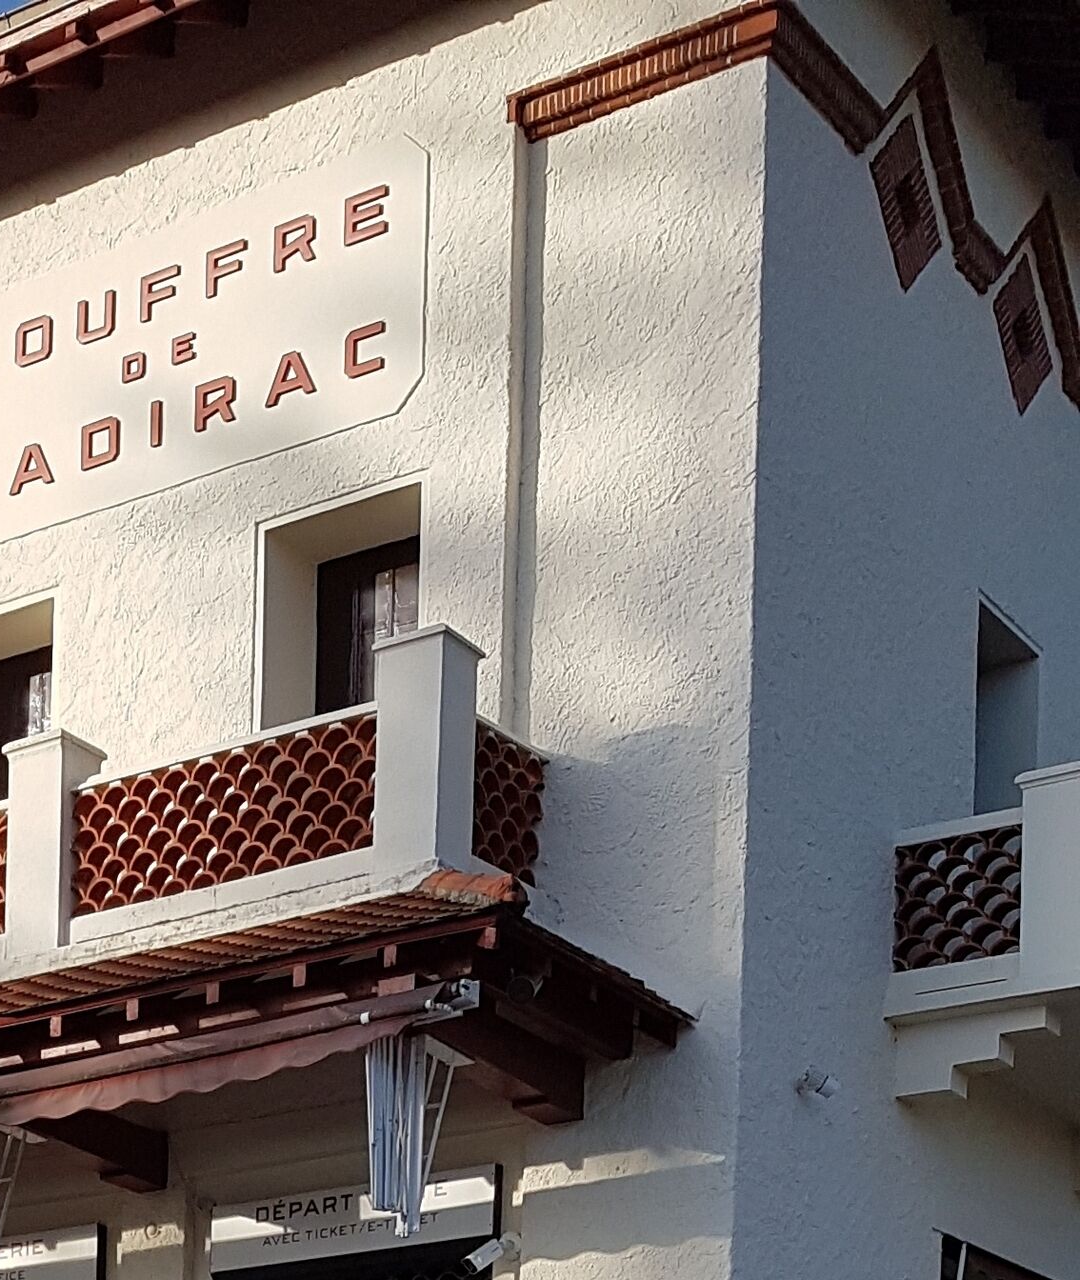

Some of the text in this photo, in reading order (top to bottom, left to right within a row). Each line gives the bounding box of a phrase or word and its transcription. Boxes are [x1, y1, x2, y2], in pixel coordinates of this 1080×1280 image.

[121, 331, 197, 384] DE
[255, 1193, 353, 1223] DÉPART
[262, 1212, 439, 1247] AVEC TICKET/E-TIET
